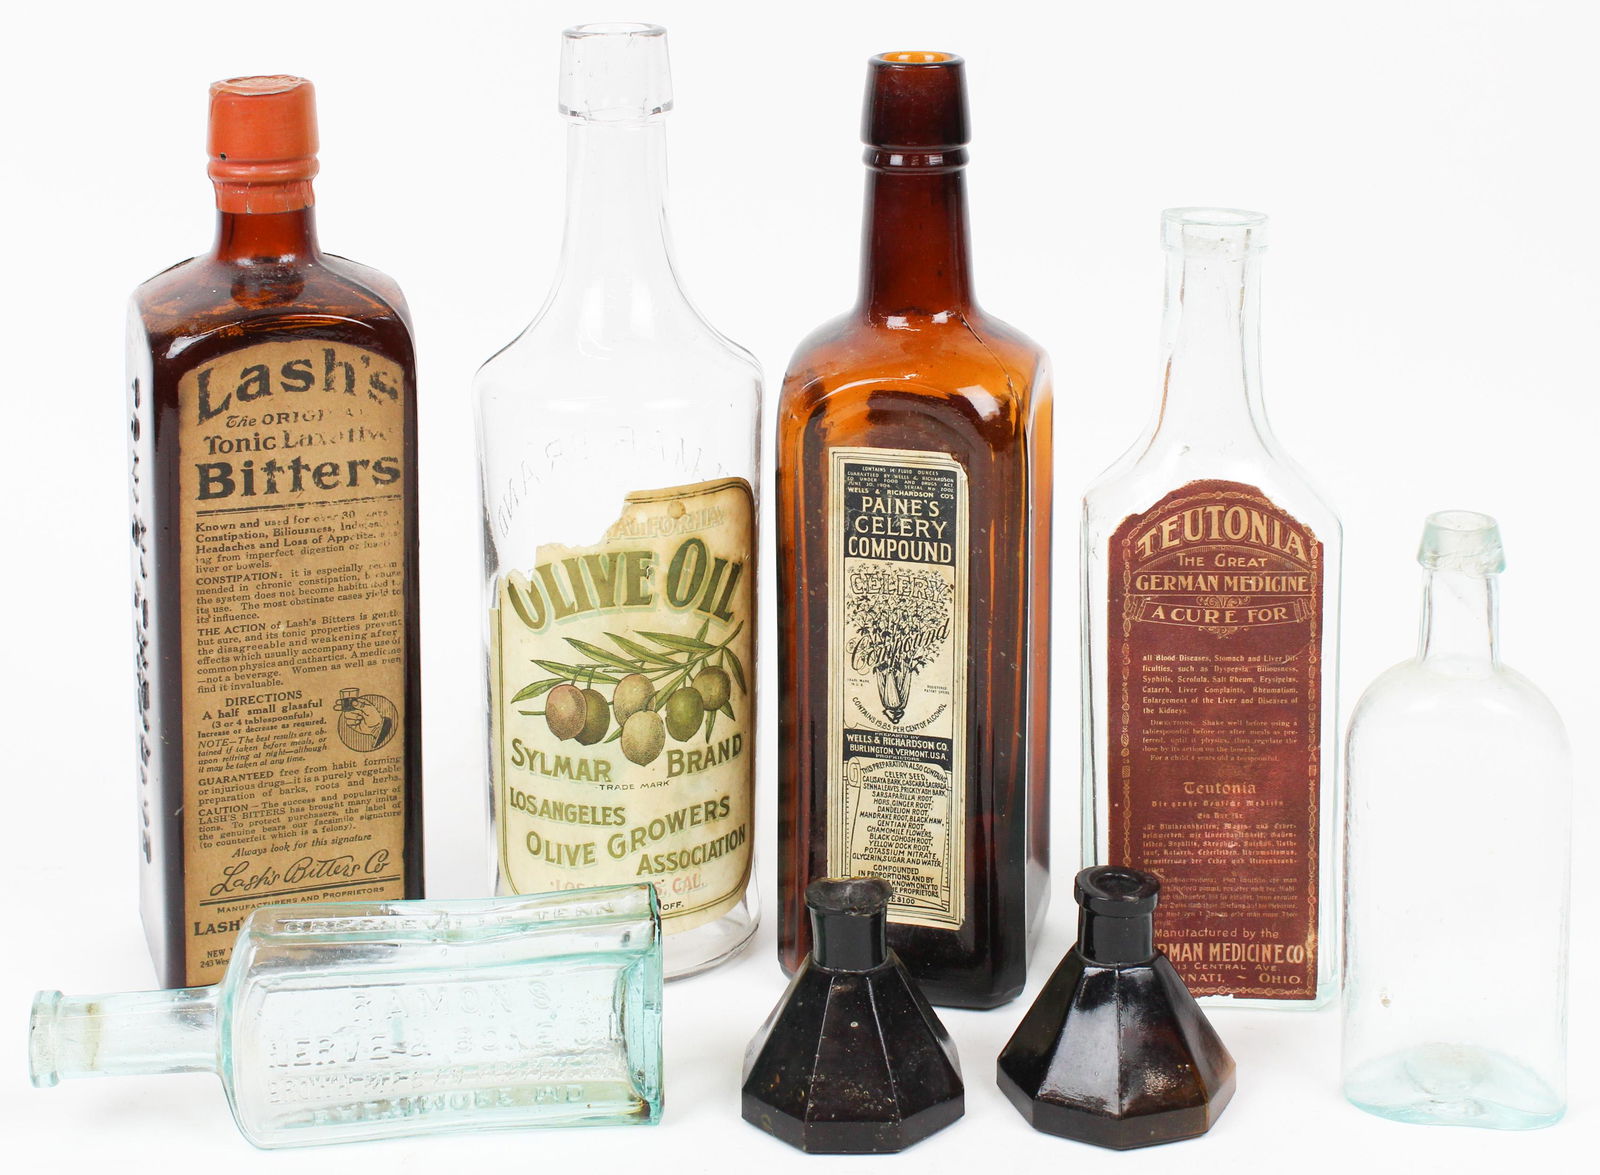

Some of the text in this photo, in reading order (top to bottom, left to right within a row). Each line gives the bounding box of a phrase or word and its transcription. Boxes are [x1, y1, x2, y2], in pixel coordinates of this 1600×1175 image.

[197, 347, 399, 425] Lash's
[226, 415, 256, 428] The
[203, 432, 277, 455] Tonic
[195, 456, 401, 500] Bitters
[887, 490, 934, 498] RICHARDSON
[862, 496, 939, 517] PAINE'S
[196, 522, 235, 532] Known
[240, 519, 259, 528] and
[265, 517, 289, 526] used
[294, 515, 309, 524] for
[610, 508, 727, 539] ALIFORNIA
[855, 516, 948, 539] CELERY
[196, 526, 335, 543] Constipation, Biliousness,
[1135, 506, 1310, 562] TEUTONIA
[196, 542, 255, 554] Headaches
[260, 540, 279, 549] and
[284, 538, 308, 547] Loss
[312, 536, 323, 544] of
[848, 536, 952, 563] COMPOUND
[1176, 553, 1267, 568] THE GREAT
[196, 563, 363, 585] CONSTIPATION: it is especially
[507, 537, 744, 630] OLIVE OIL
[1135, 574, 1309, 592] GERMAN MEDICINE
[196, 573, 360, 595] mended in chronic constipation,
[850, 573, 948, 601] CELERY
[197, 611, 367, 636] THE ACTION of Lash's Bitters is
[1151, 605, 1288, 623] A CURE FOR
[225, 690, 303, 707] DIRECTIONS
[202, 699, 323, 720] A half small glassful
[852, 697, 876, 723] CONTAINS
[906, 723, 920, 732] CENT
[920, 720, 927, 728] OF
[926, 703, 947, 724] ALCOHOL
[847, 734, 872, 742] WELLS
[883, 737, 934, 749] RICHARDSON
[936, 742, 949, 751] CO.
[511, 733, 742, 783] SYLMAR BRAND
[198, 755, 401, 786] GUARANTEED free from habit forming
[885, 771, 907, 779] CELERY
[640, 780, 671, 789] MARK
[1183, 782, 1257, 794] Teutonia
[538, 799, 627, 826] ANGELES
[878, 806, 910, 814] DANDELION
[526, 795, 731, 867] OLIVE GROWERS
[867, 826, 904, 835] CHAMOMILE
[232, 833, 372, 858] Always look for this signature
[636, 824, 746, 876] ASSOCIATION
[865, 847, 938, 861] POTASSIUM NITRATE,
[209, 860, 280, 896] Lash's
[284, 855, 361, 884] Bitters
[867, 870, 910, 880] PROPORTIONS
[912, 874, 925, 882] AND
[873, 865, 919, 875] COMPOUNDED
[301, 894, 320, 903] AND
[323, 886, 384, 899] PROPRIETORS
[662, 901, 684, 911] OFF.
[194, 917, 243, 936] LASH'
[1154, 928, 1279, 940] Manufactured by the
[207, 949, 225, 958] NEW
[1157, 943, 1203, 962] RMAN
[1209, 943, 1284, 963] MEDICINE
